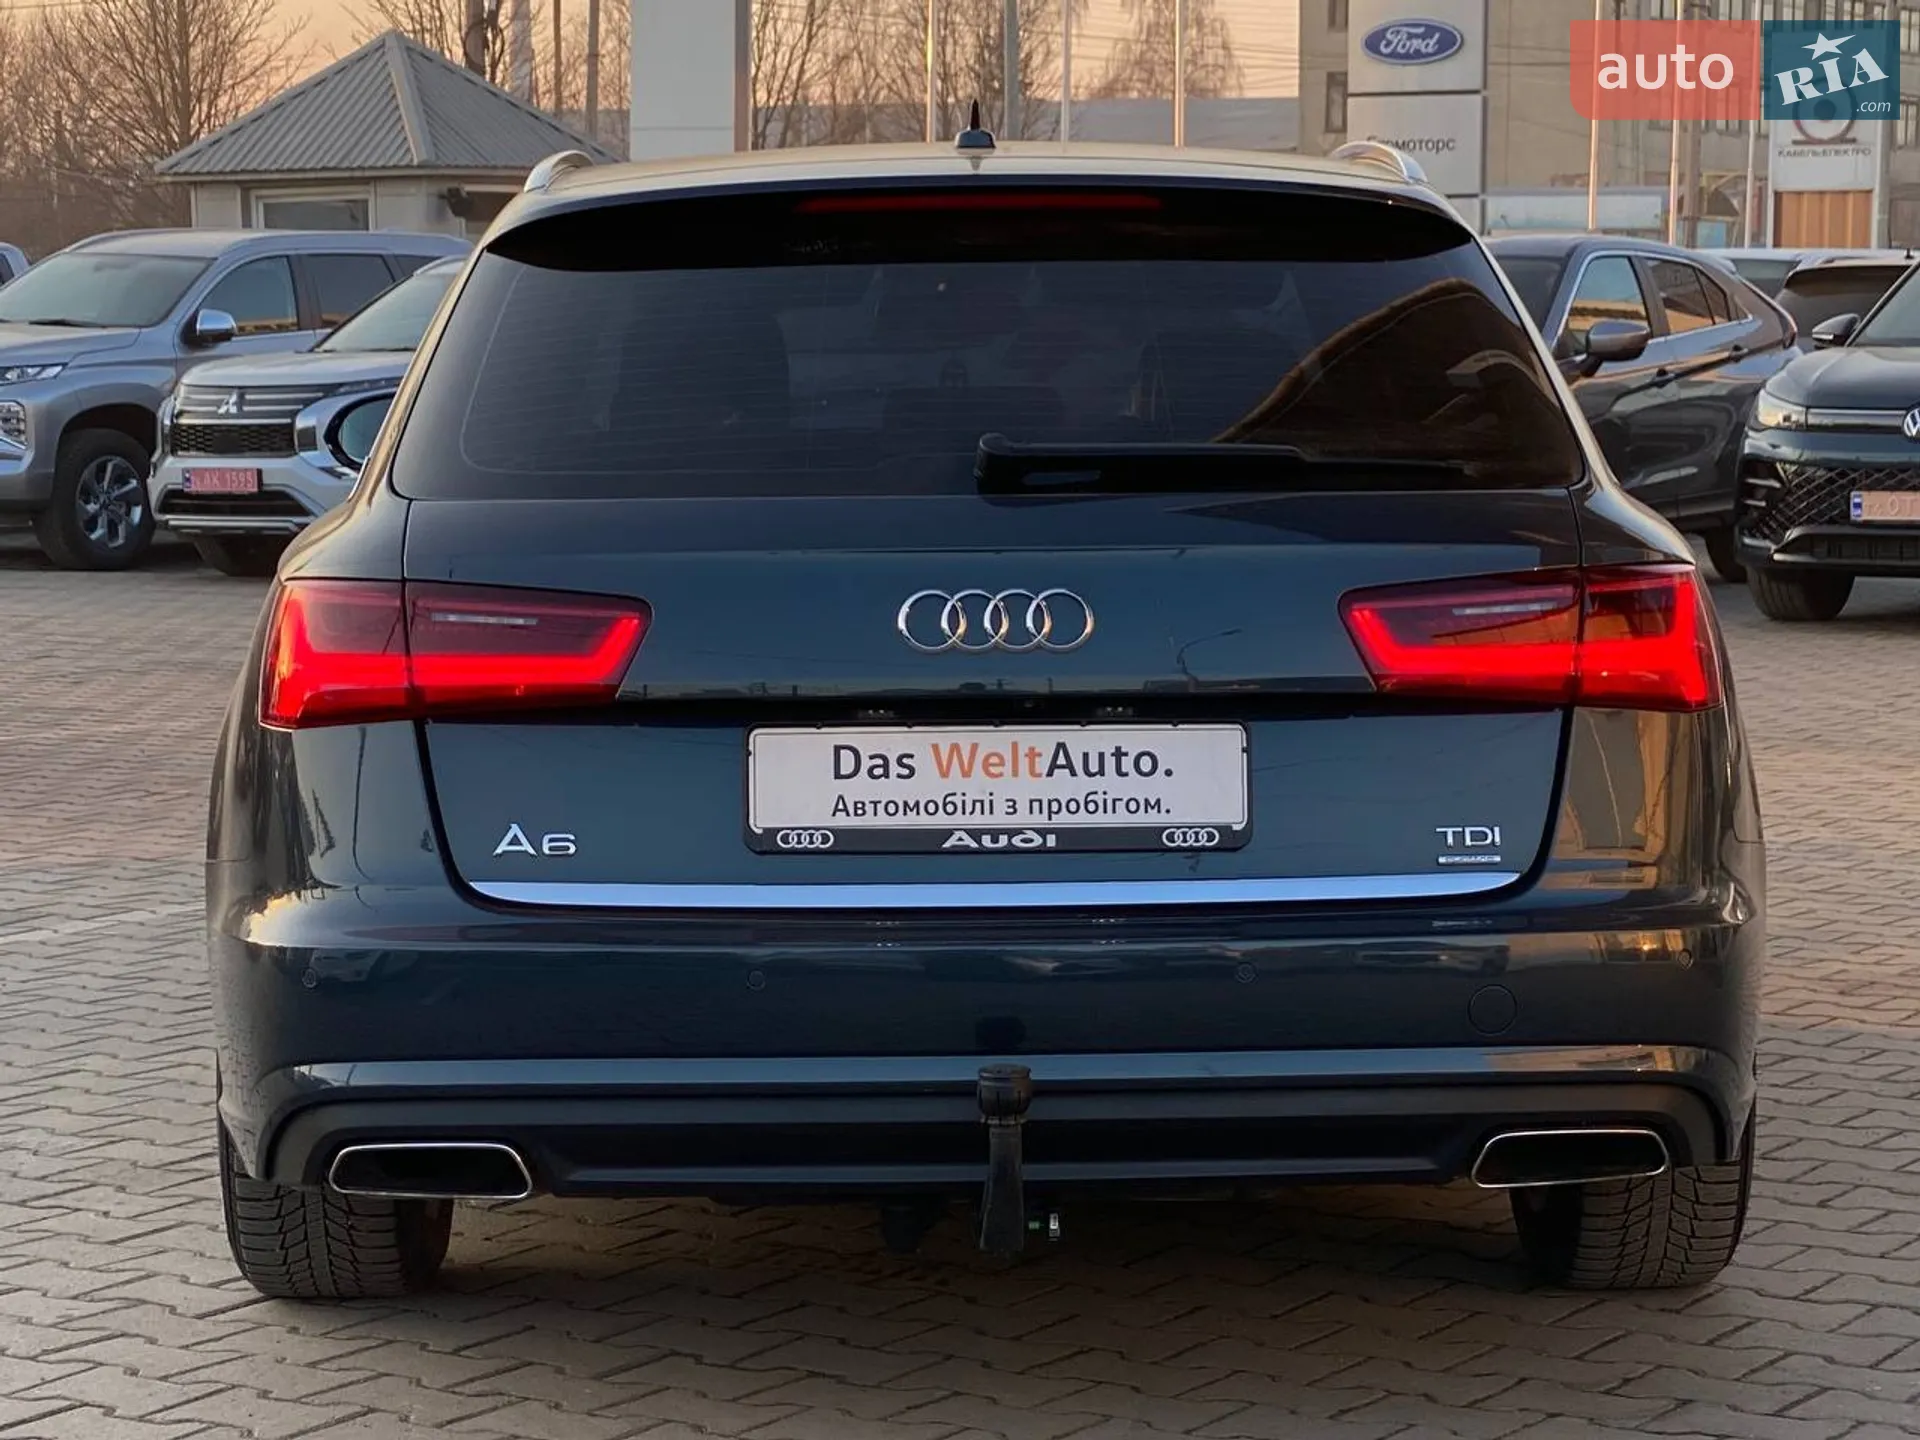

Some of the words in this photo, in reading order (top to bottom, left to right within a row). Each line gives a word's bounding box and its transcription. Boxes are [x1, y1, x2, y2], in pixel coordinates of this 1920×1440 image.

[1379, 26, 1441, 55] Ford
[832, 744, 917, 780] Das
[930, 741, 1174, 780] WeltAuto.
[831, 792, 995, 818] Автомобілі
[1004, 797, 1019, 816] з
[1028, 790, 1172, 821] пробігом.
[492, 823, 577, 856] A6
[940, 830, 1057, 849] Audi
[1435, 826, 1501, 847] TDI
